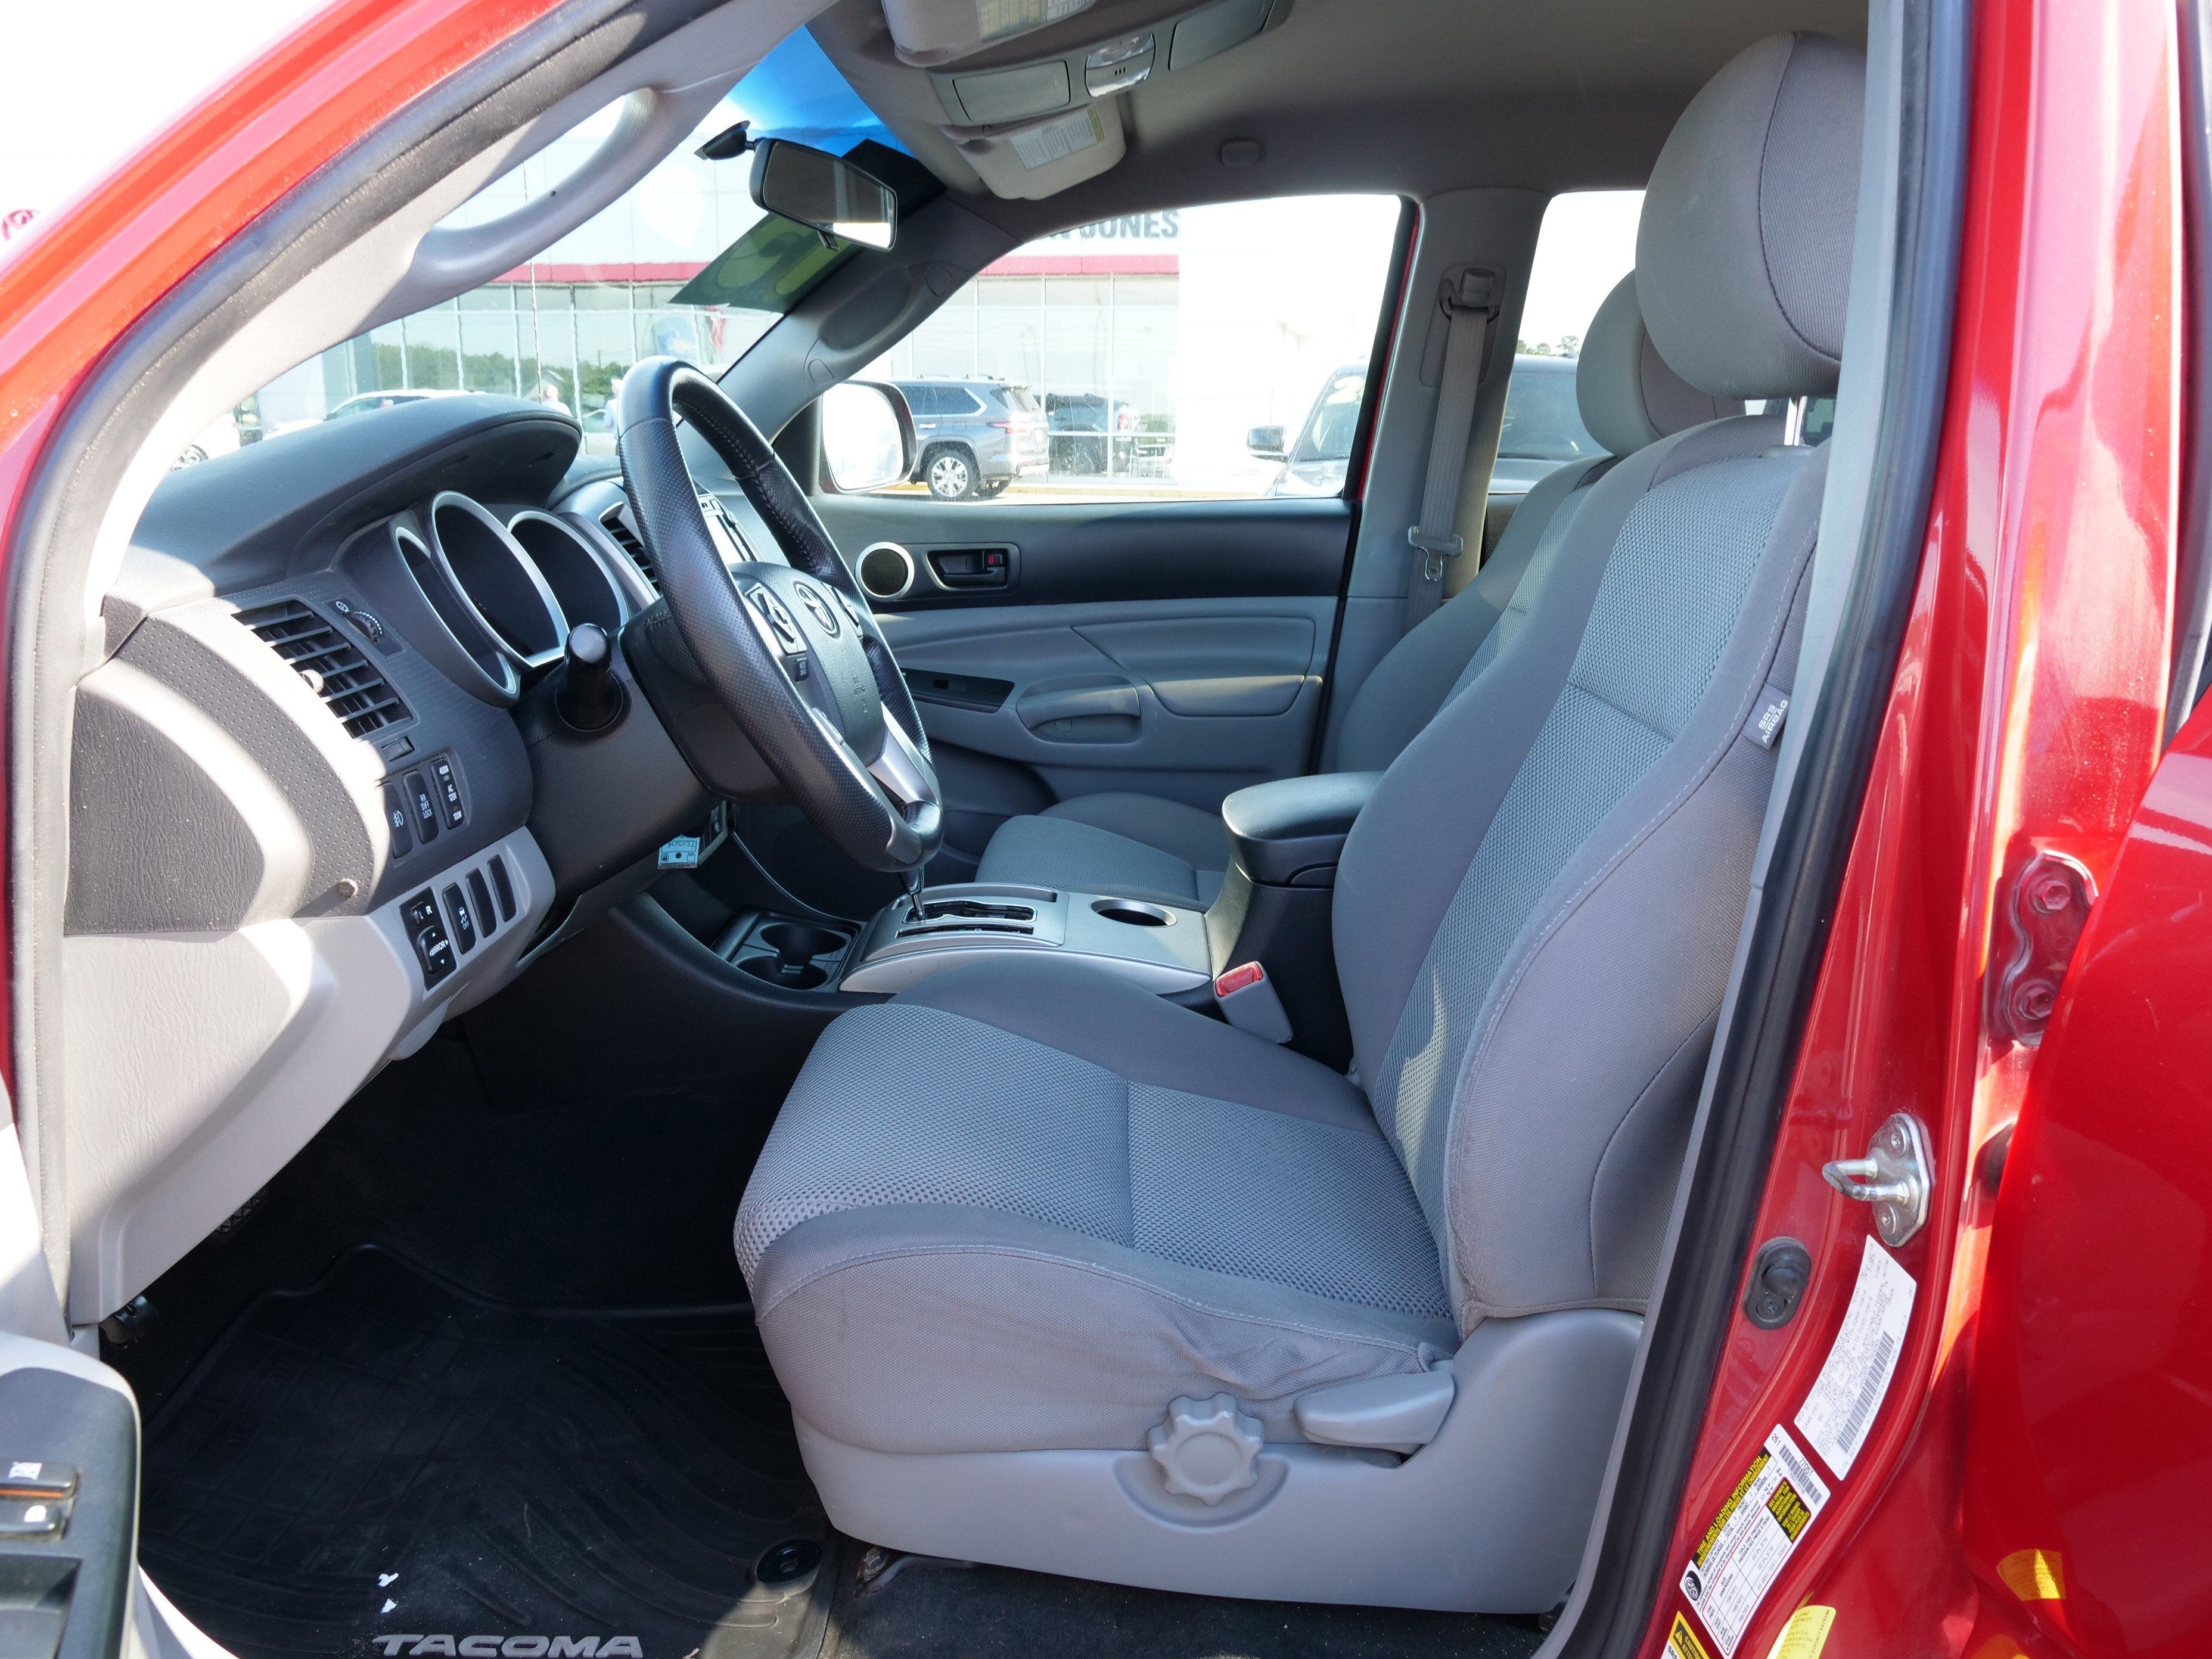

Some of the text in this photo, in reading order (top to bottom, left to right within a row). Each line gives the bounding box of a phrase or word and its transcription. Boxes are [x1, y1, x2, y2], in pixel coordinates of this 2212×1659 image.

[1759, 704, 1776, 729] SRS
[1762, 700, 1788, 743] AIRBAG
[420, 794, 426, 802] RR
[448, 784, 453, 793] AC
[449, 791, 457, 801] 120V
[421, 800, 429, 810] DIFF
[423, 809, 433, 819] LOCK
[425, 905, 433, 915] R
[430, 940, 446, 956] MIRROR
[1810, 1378, 1822, 1400] TOYOTA
[1821, 1358, 1832, 1378] MOTOR
[1771, 1433, 1781, 1446] 261
[1696, 1455, 1761, 1556] TIRE AND LOADING INFORMATION
[1697, 1526, 1720, 1567] RENSEIGNEMENTS
[1729, 1495, 1741, 1511] PNEUS
[1739, 1489, 1745, 1497] ET
[1743, 1483, 1750, 1492] LE
[1747, 1453, 1769, 1486] CHARGEMENT
[1775, 1490, 1792, 1515] ADDITIONAL
[1777, 1492, 1797, 1522] INFORMATION
[1750, 1515, 1764, 1537] PRESSURE
[1719, 1572, 1733, 1598] DIMENSIONS
[372, 1634, 644, 1658] TACOMA
[1685, 1636, 1701, 1659] CAUTIO
